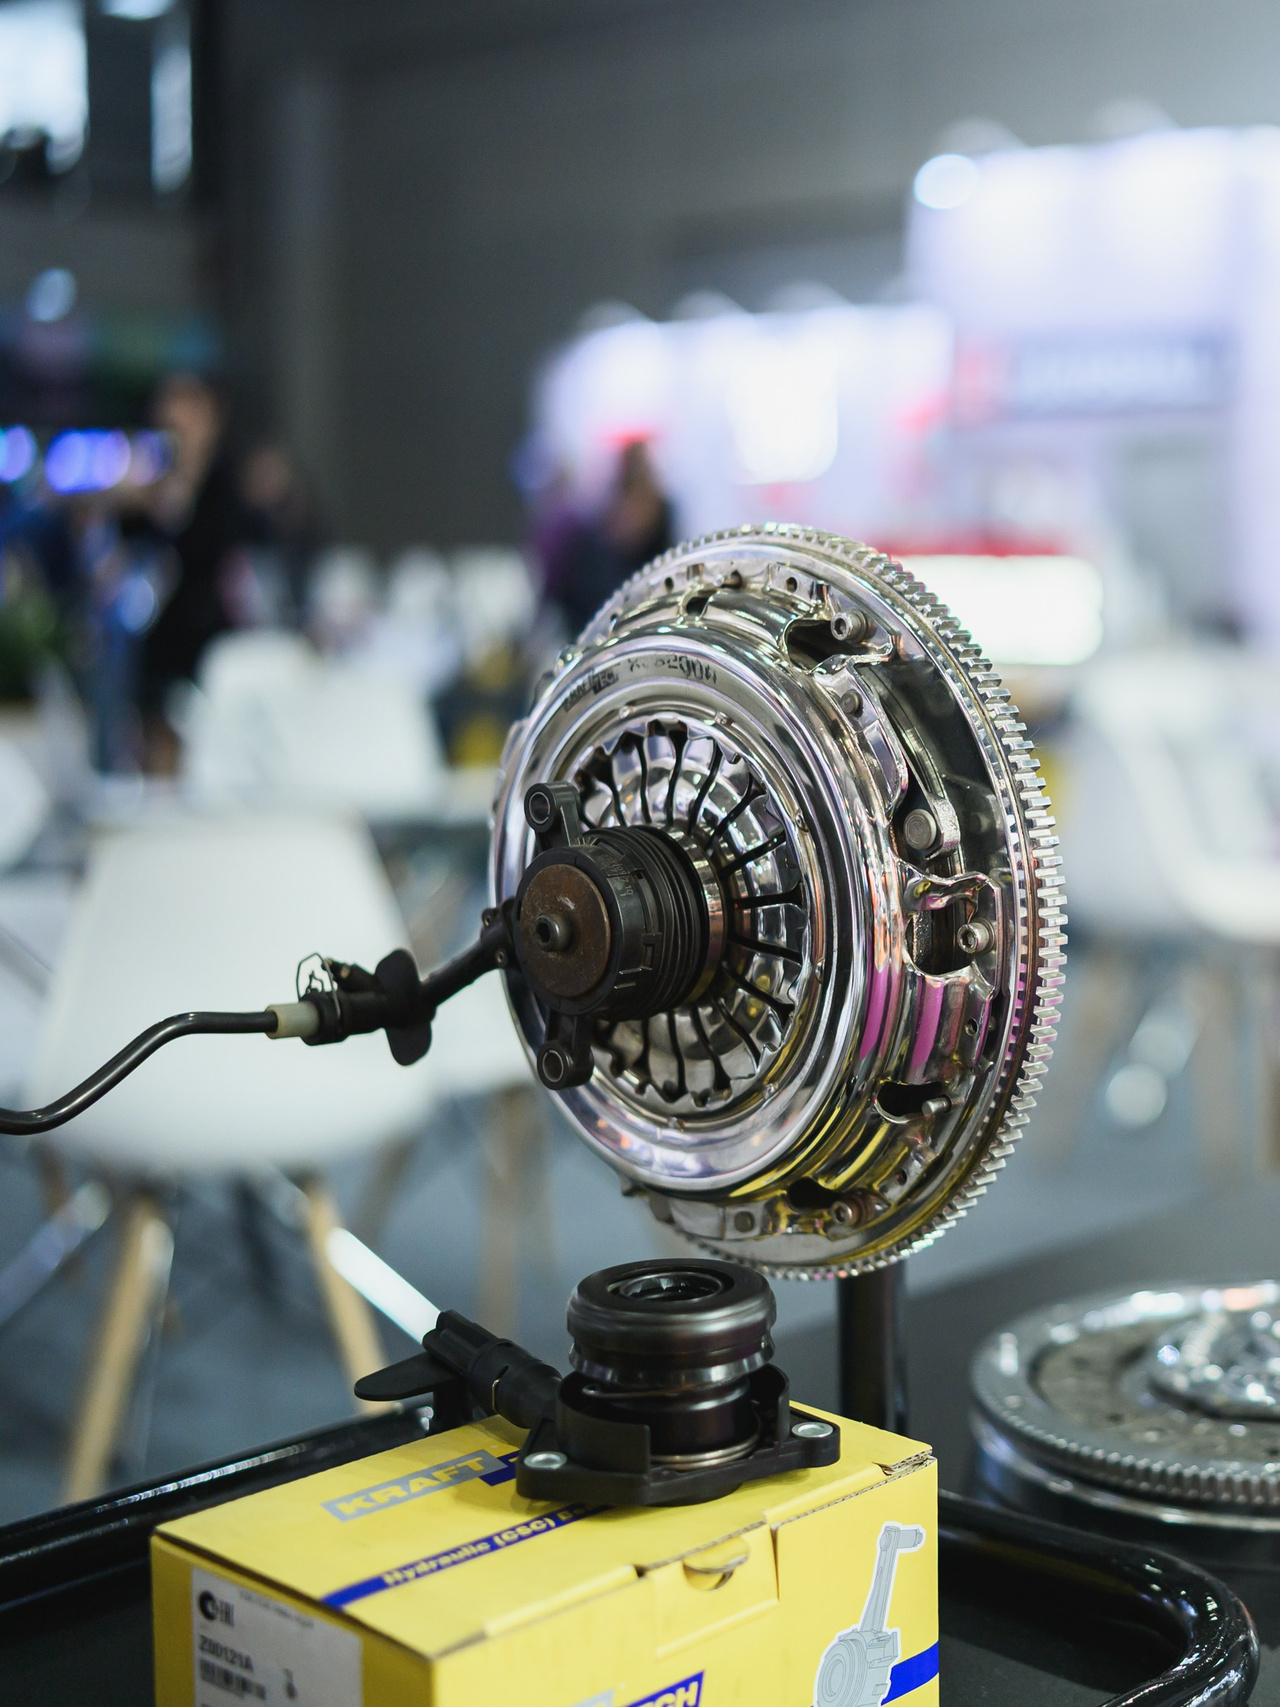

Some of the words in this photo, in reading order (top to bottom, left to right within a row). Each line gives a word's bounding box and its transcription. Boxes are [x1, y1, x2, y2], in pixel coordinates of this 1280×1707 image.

[336, 1456, 484, 1515] KRAFT
[382, 1541, 491, 1586] Hydraulic
[493, 1517, 556, 1547] (CSC)
